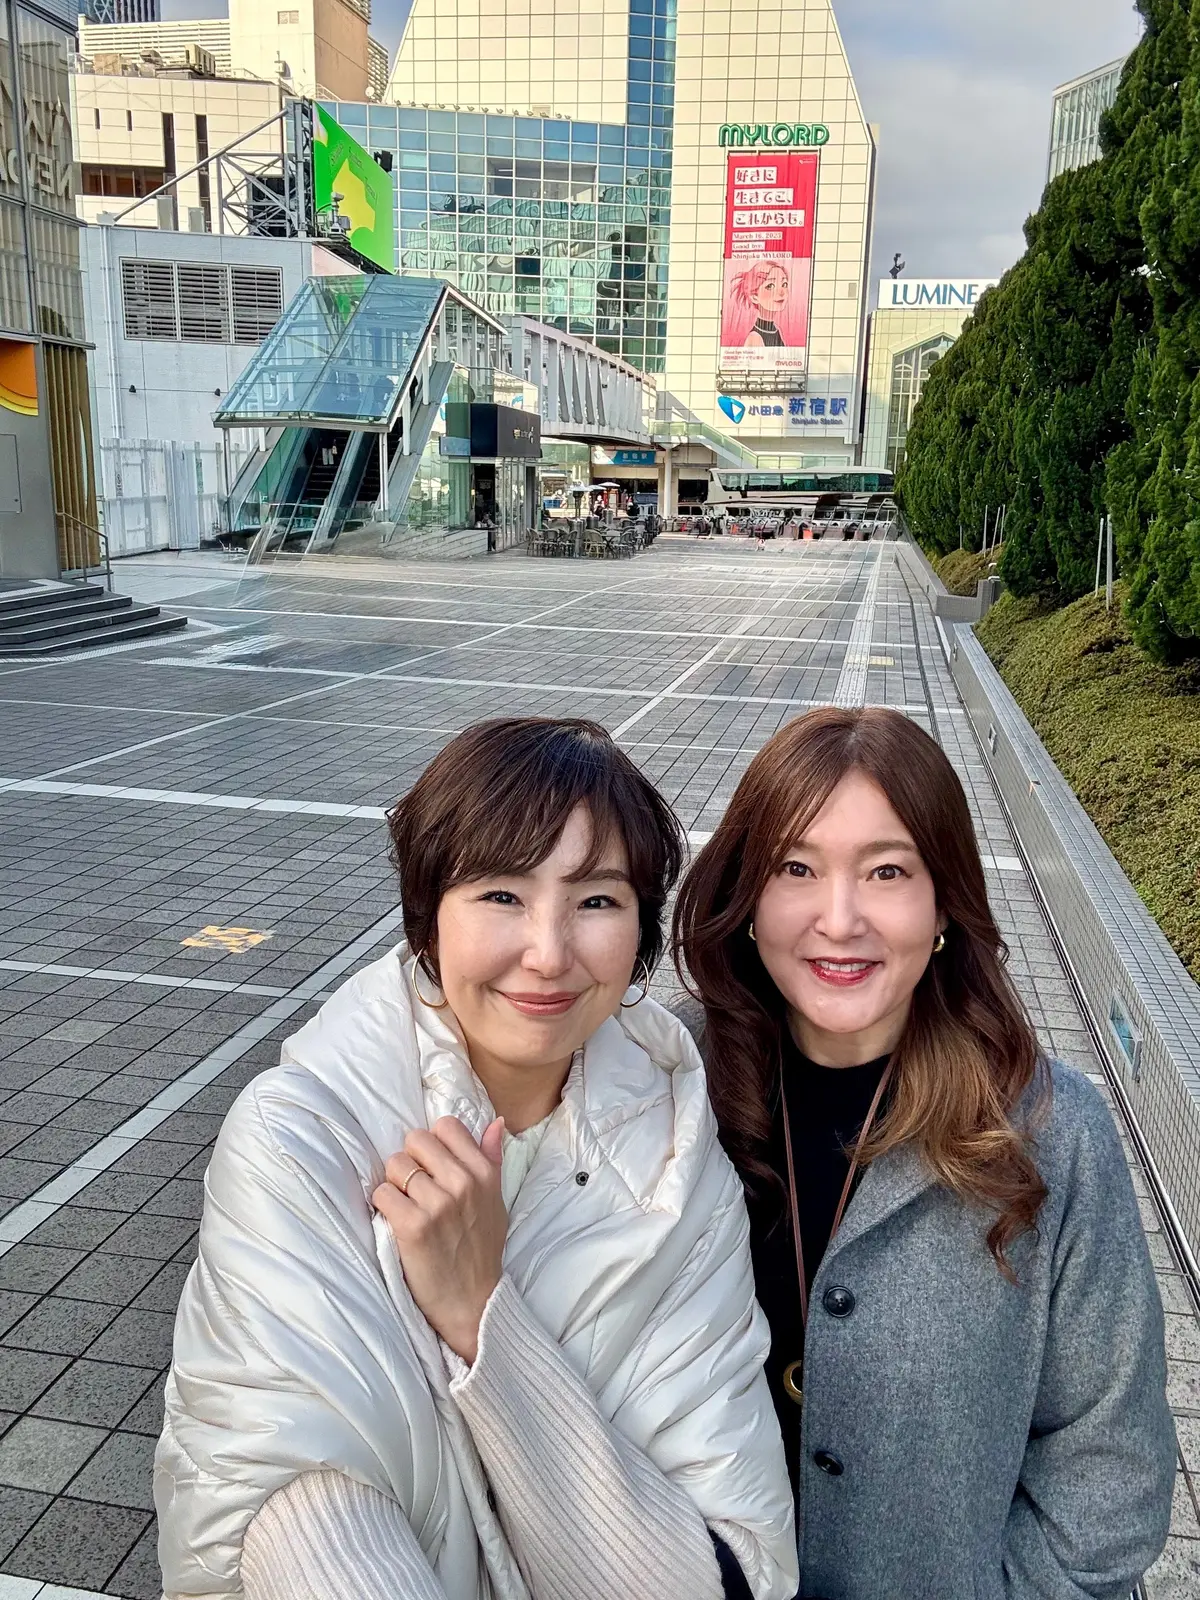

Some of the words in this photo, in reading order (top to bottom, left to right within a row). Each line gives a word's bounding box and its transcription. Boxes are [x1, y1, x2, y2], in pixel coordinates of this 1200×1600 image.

[719, 123, 829, 147] MYLORD
[736, 169, 774, 183] 好きに
[736, 191, 791, 204] 生きてこ、
[735, 212, 802, 225] これからも。
[892, 283, 979, 305] LUMINE
[748, 405, 784, 416] 小田急
[788, 396, 848, 417] 新宿駅
[791, 417, 819, 426] Shinjuku
[820, 417, 843, 425] Station
